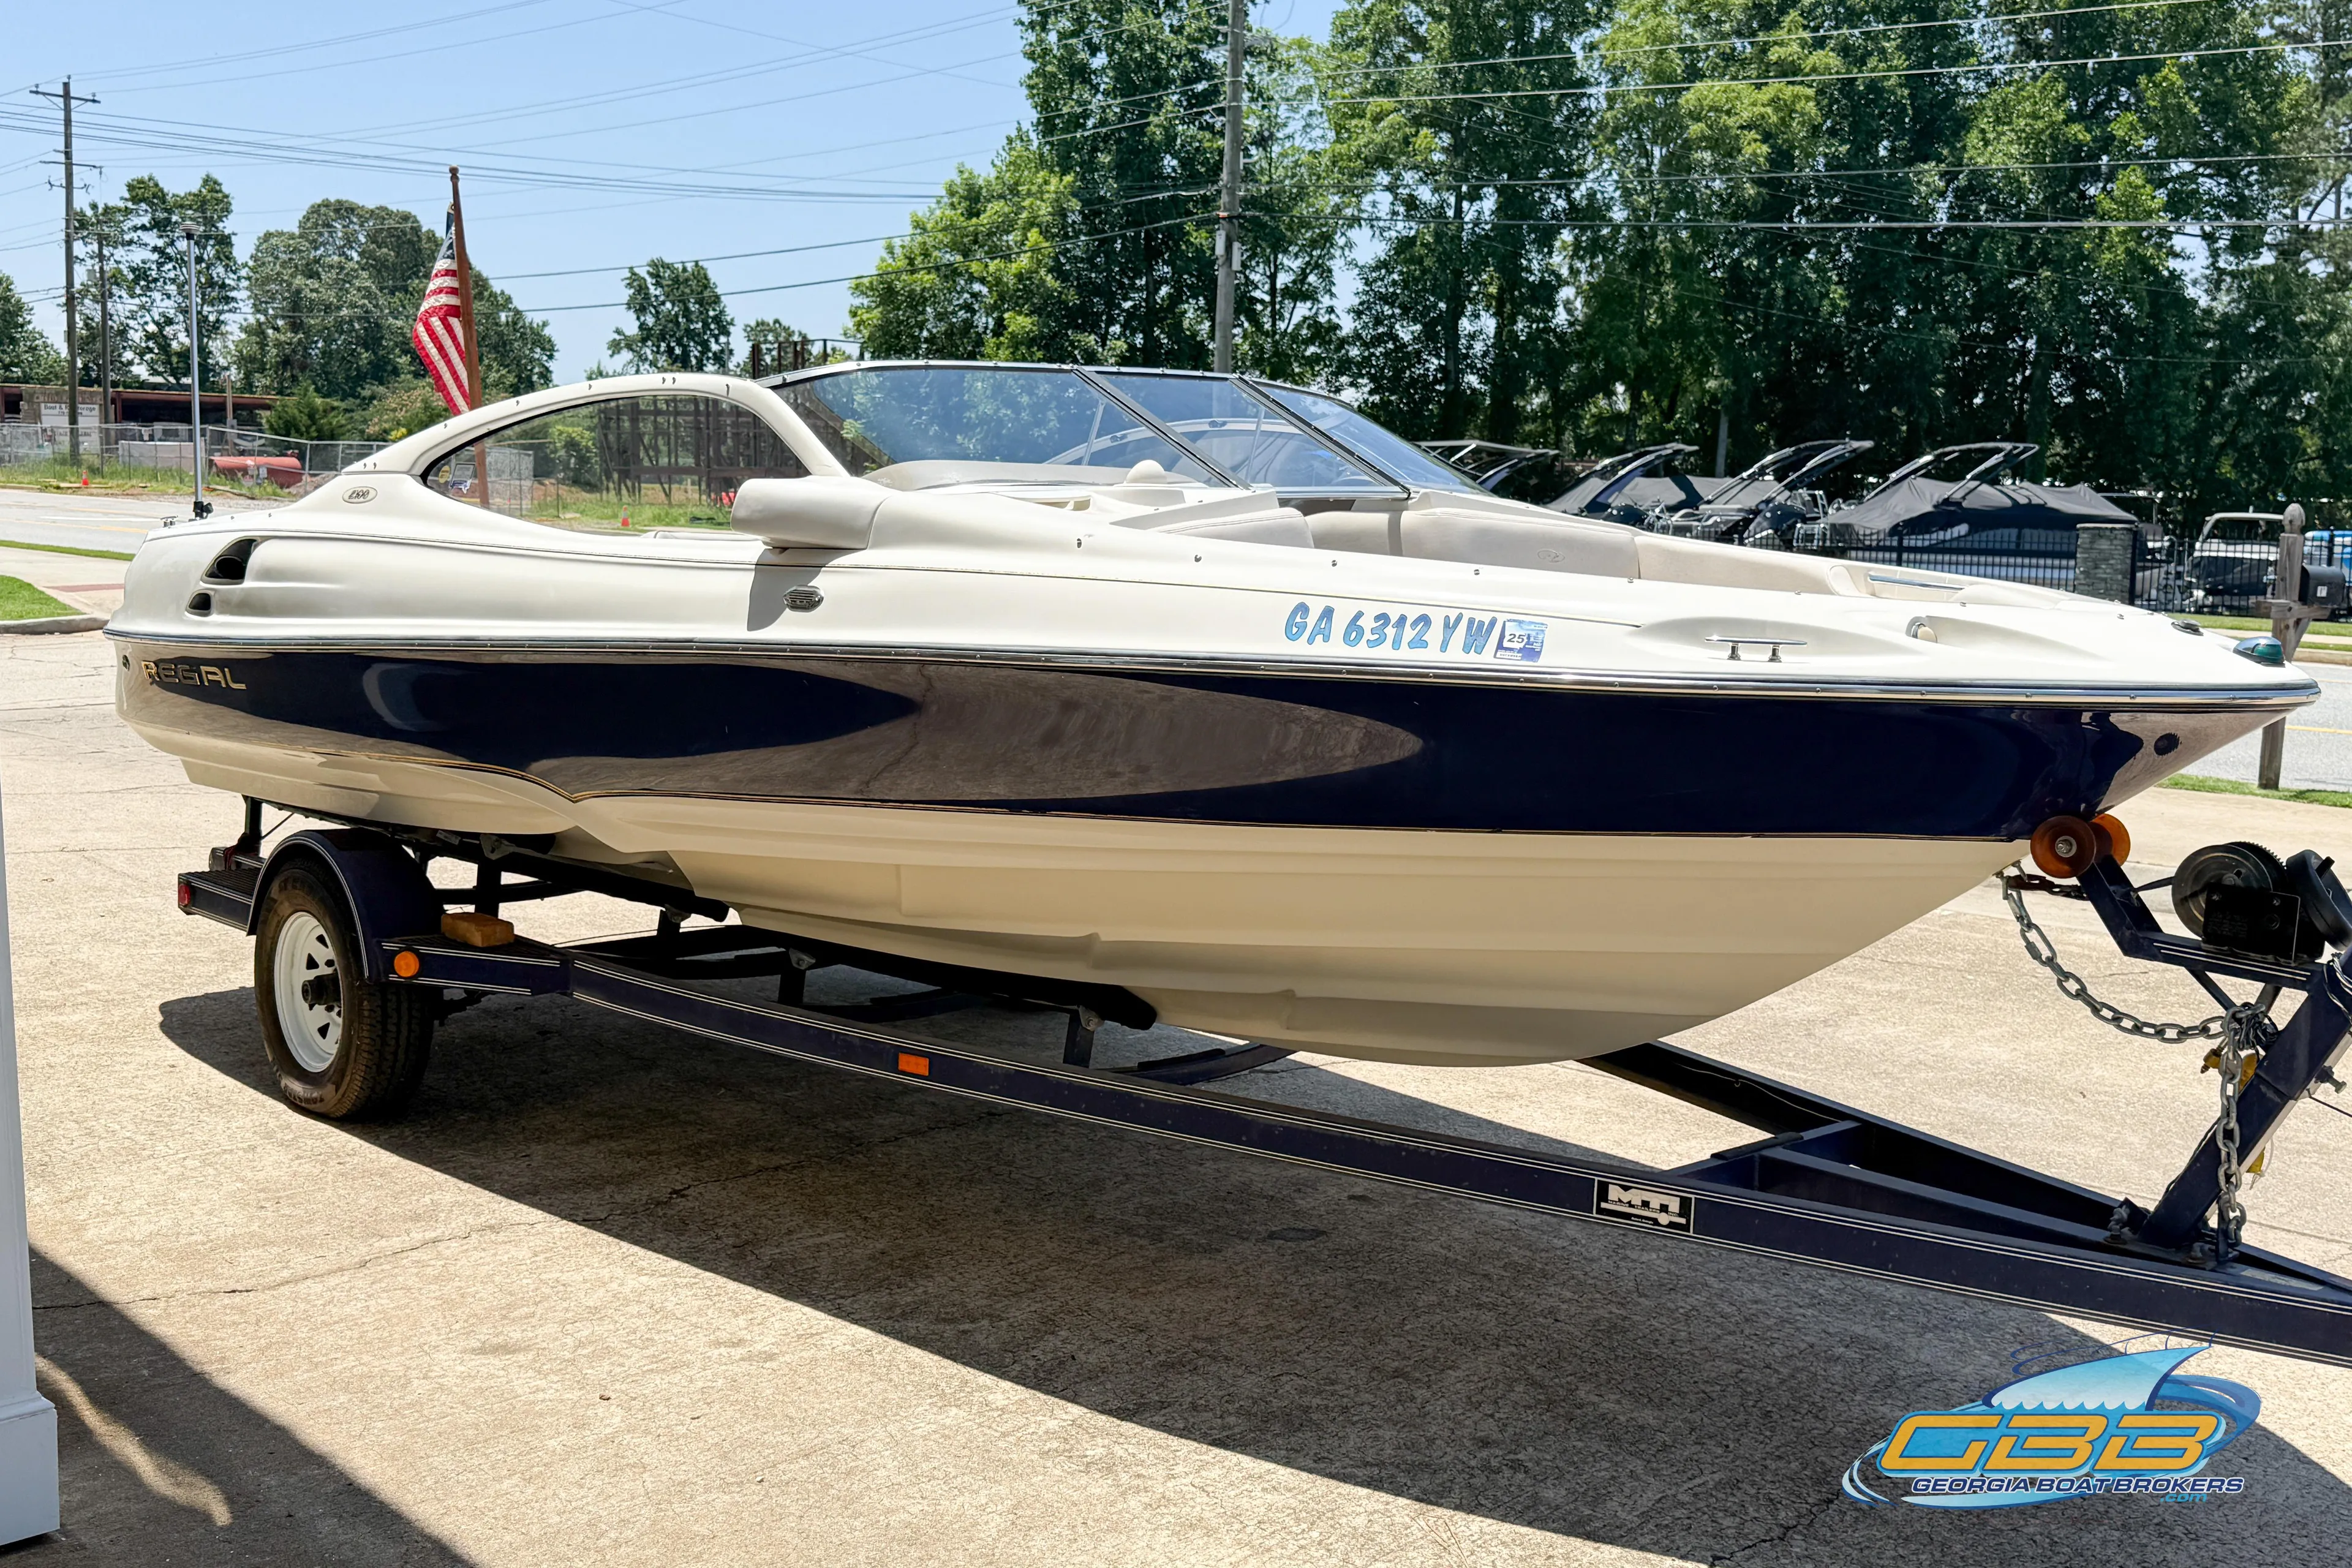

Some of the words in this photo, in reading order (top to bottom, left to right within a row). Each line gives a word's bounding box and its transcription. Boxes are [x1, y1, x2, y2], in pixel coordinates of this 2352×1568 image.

[1284, 601, 1335, 645] GA
[1343, 611, 1432, 650] 6312
[1439, 612, 1498, 654] YW
[1507, 633, 1526, 643] 25
[141, 660, 247, 690] REGAL
